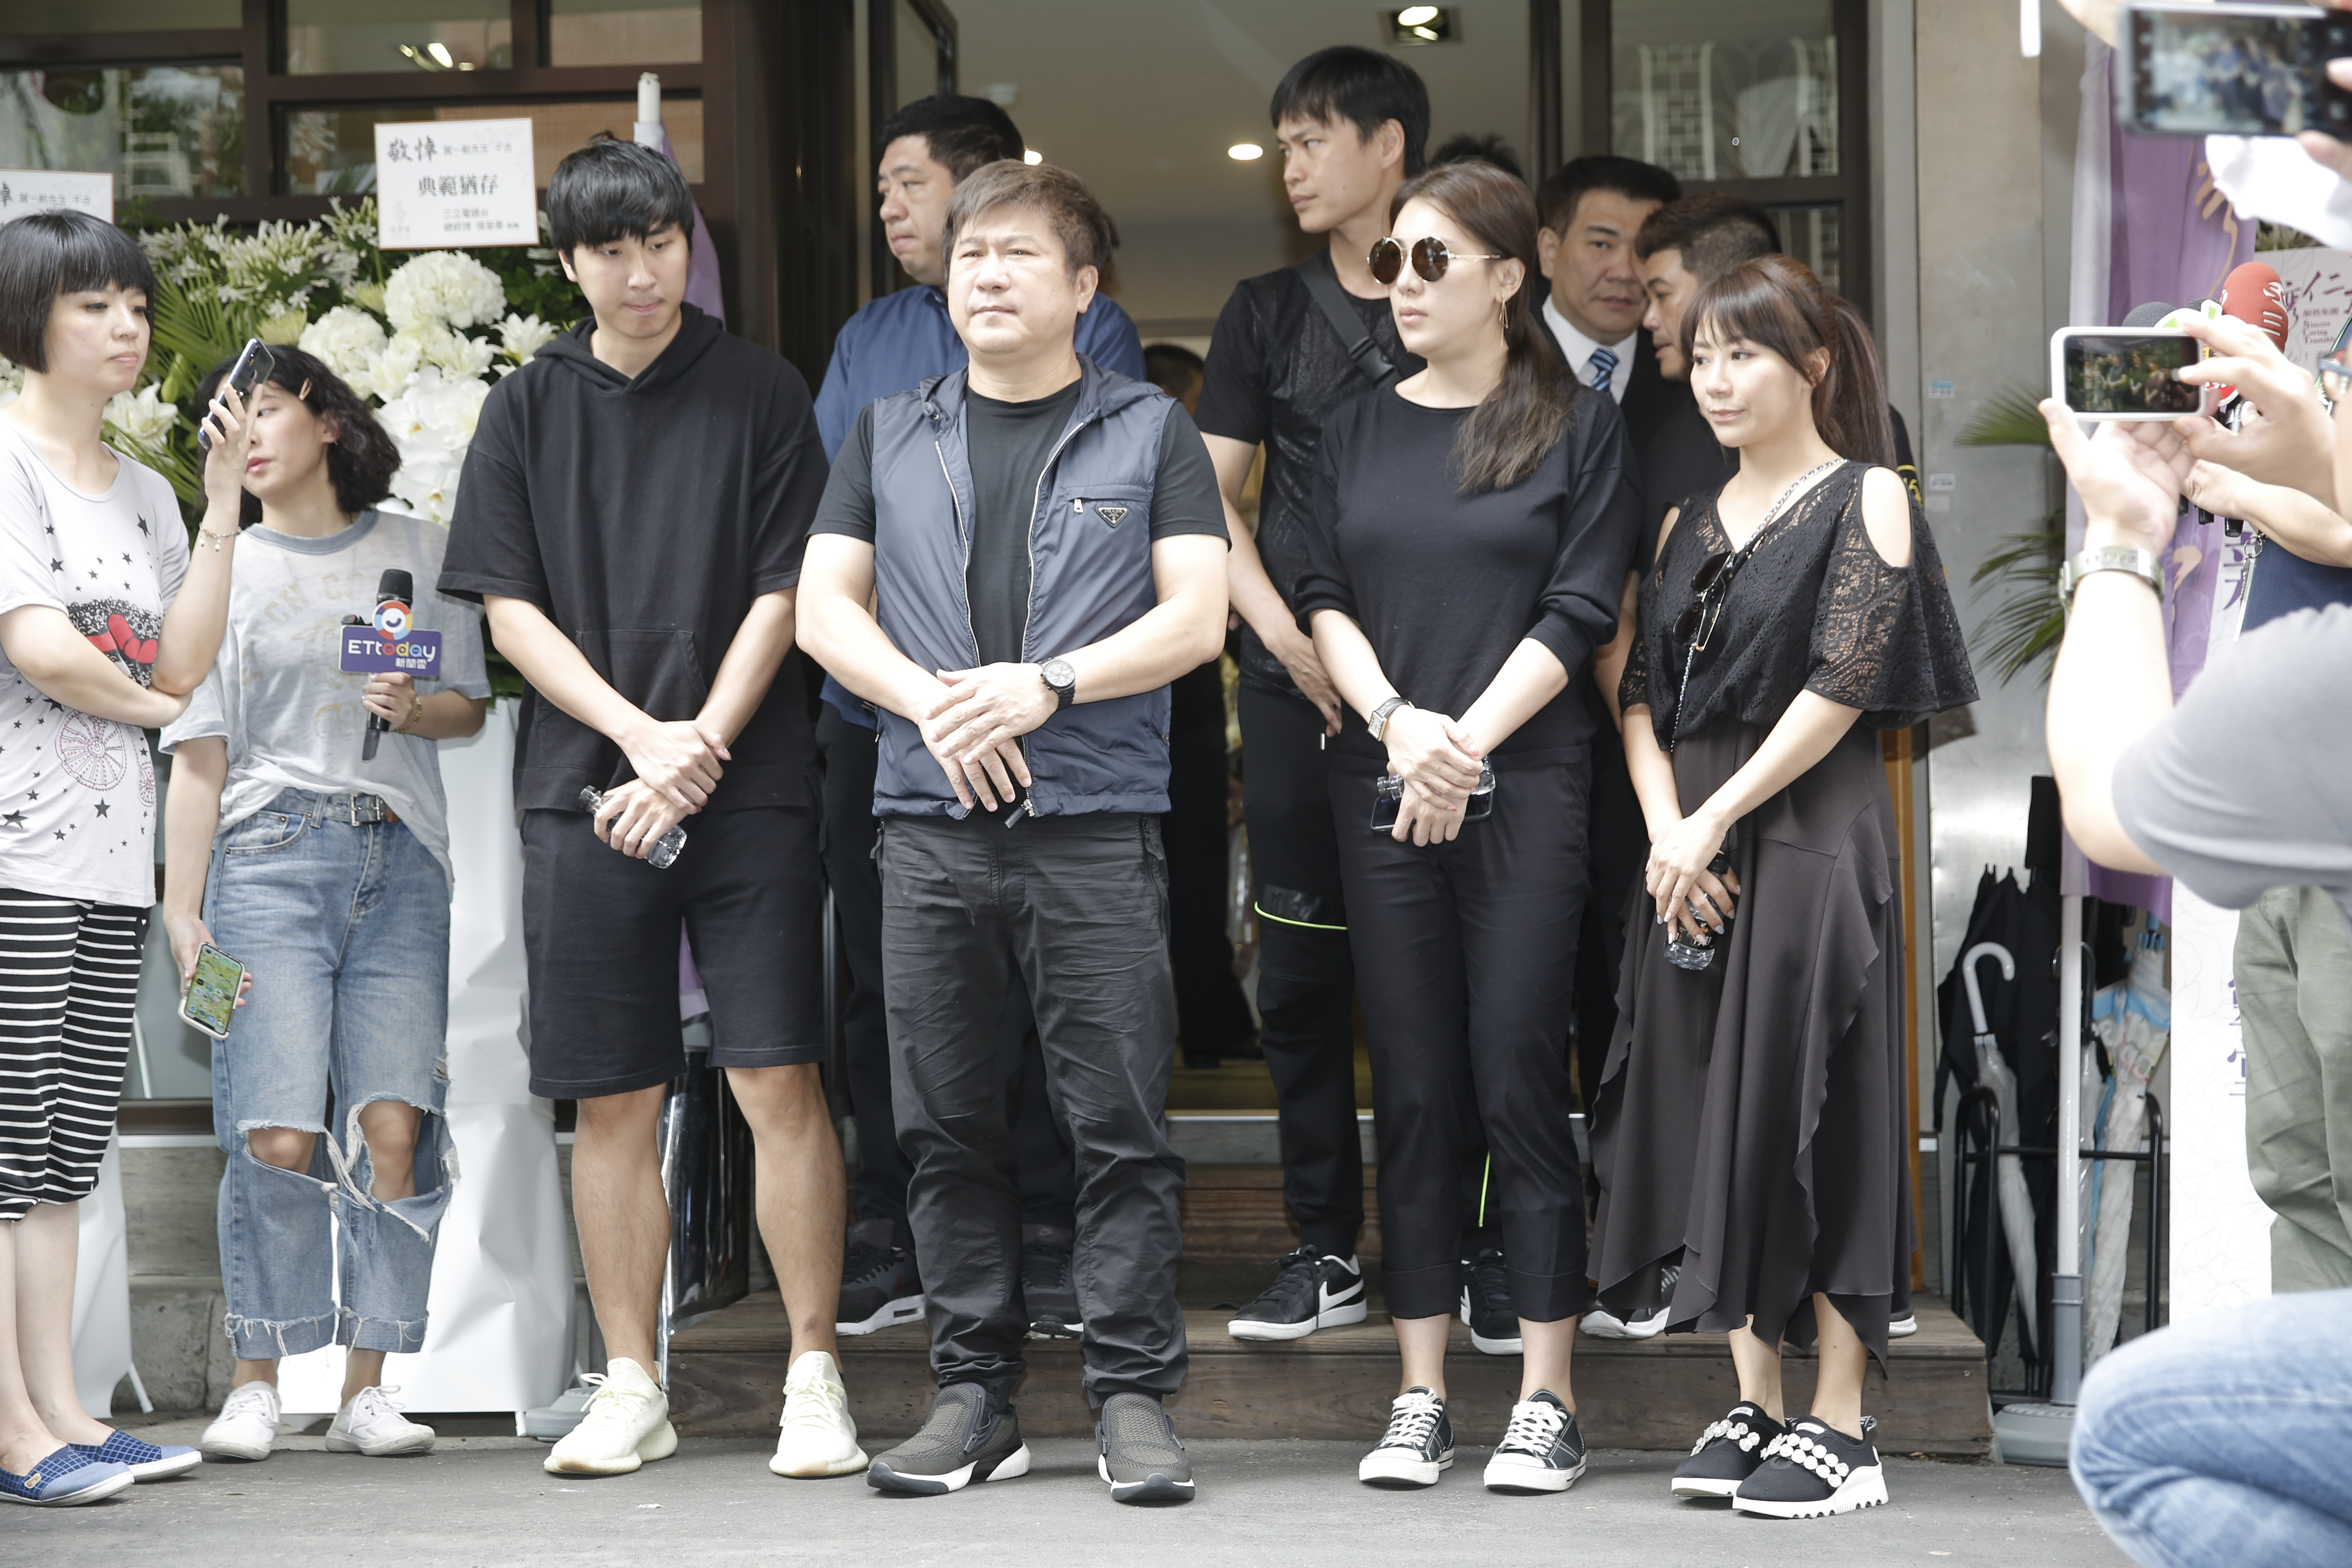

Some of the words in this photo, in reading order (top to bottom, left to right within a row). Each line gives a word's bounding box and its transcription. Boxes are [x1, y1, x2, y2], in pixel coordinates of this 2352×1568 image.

[388, 135, 438, 163] 敬悼
[419, 173, 498, 197] 典範猶存
[2303, 327, 2328, 336] Caring
[348, 639, 436, 662] ETtoday
[395, 657, 428, 670] 新聞雲
